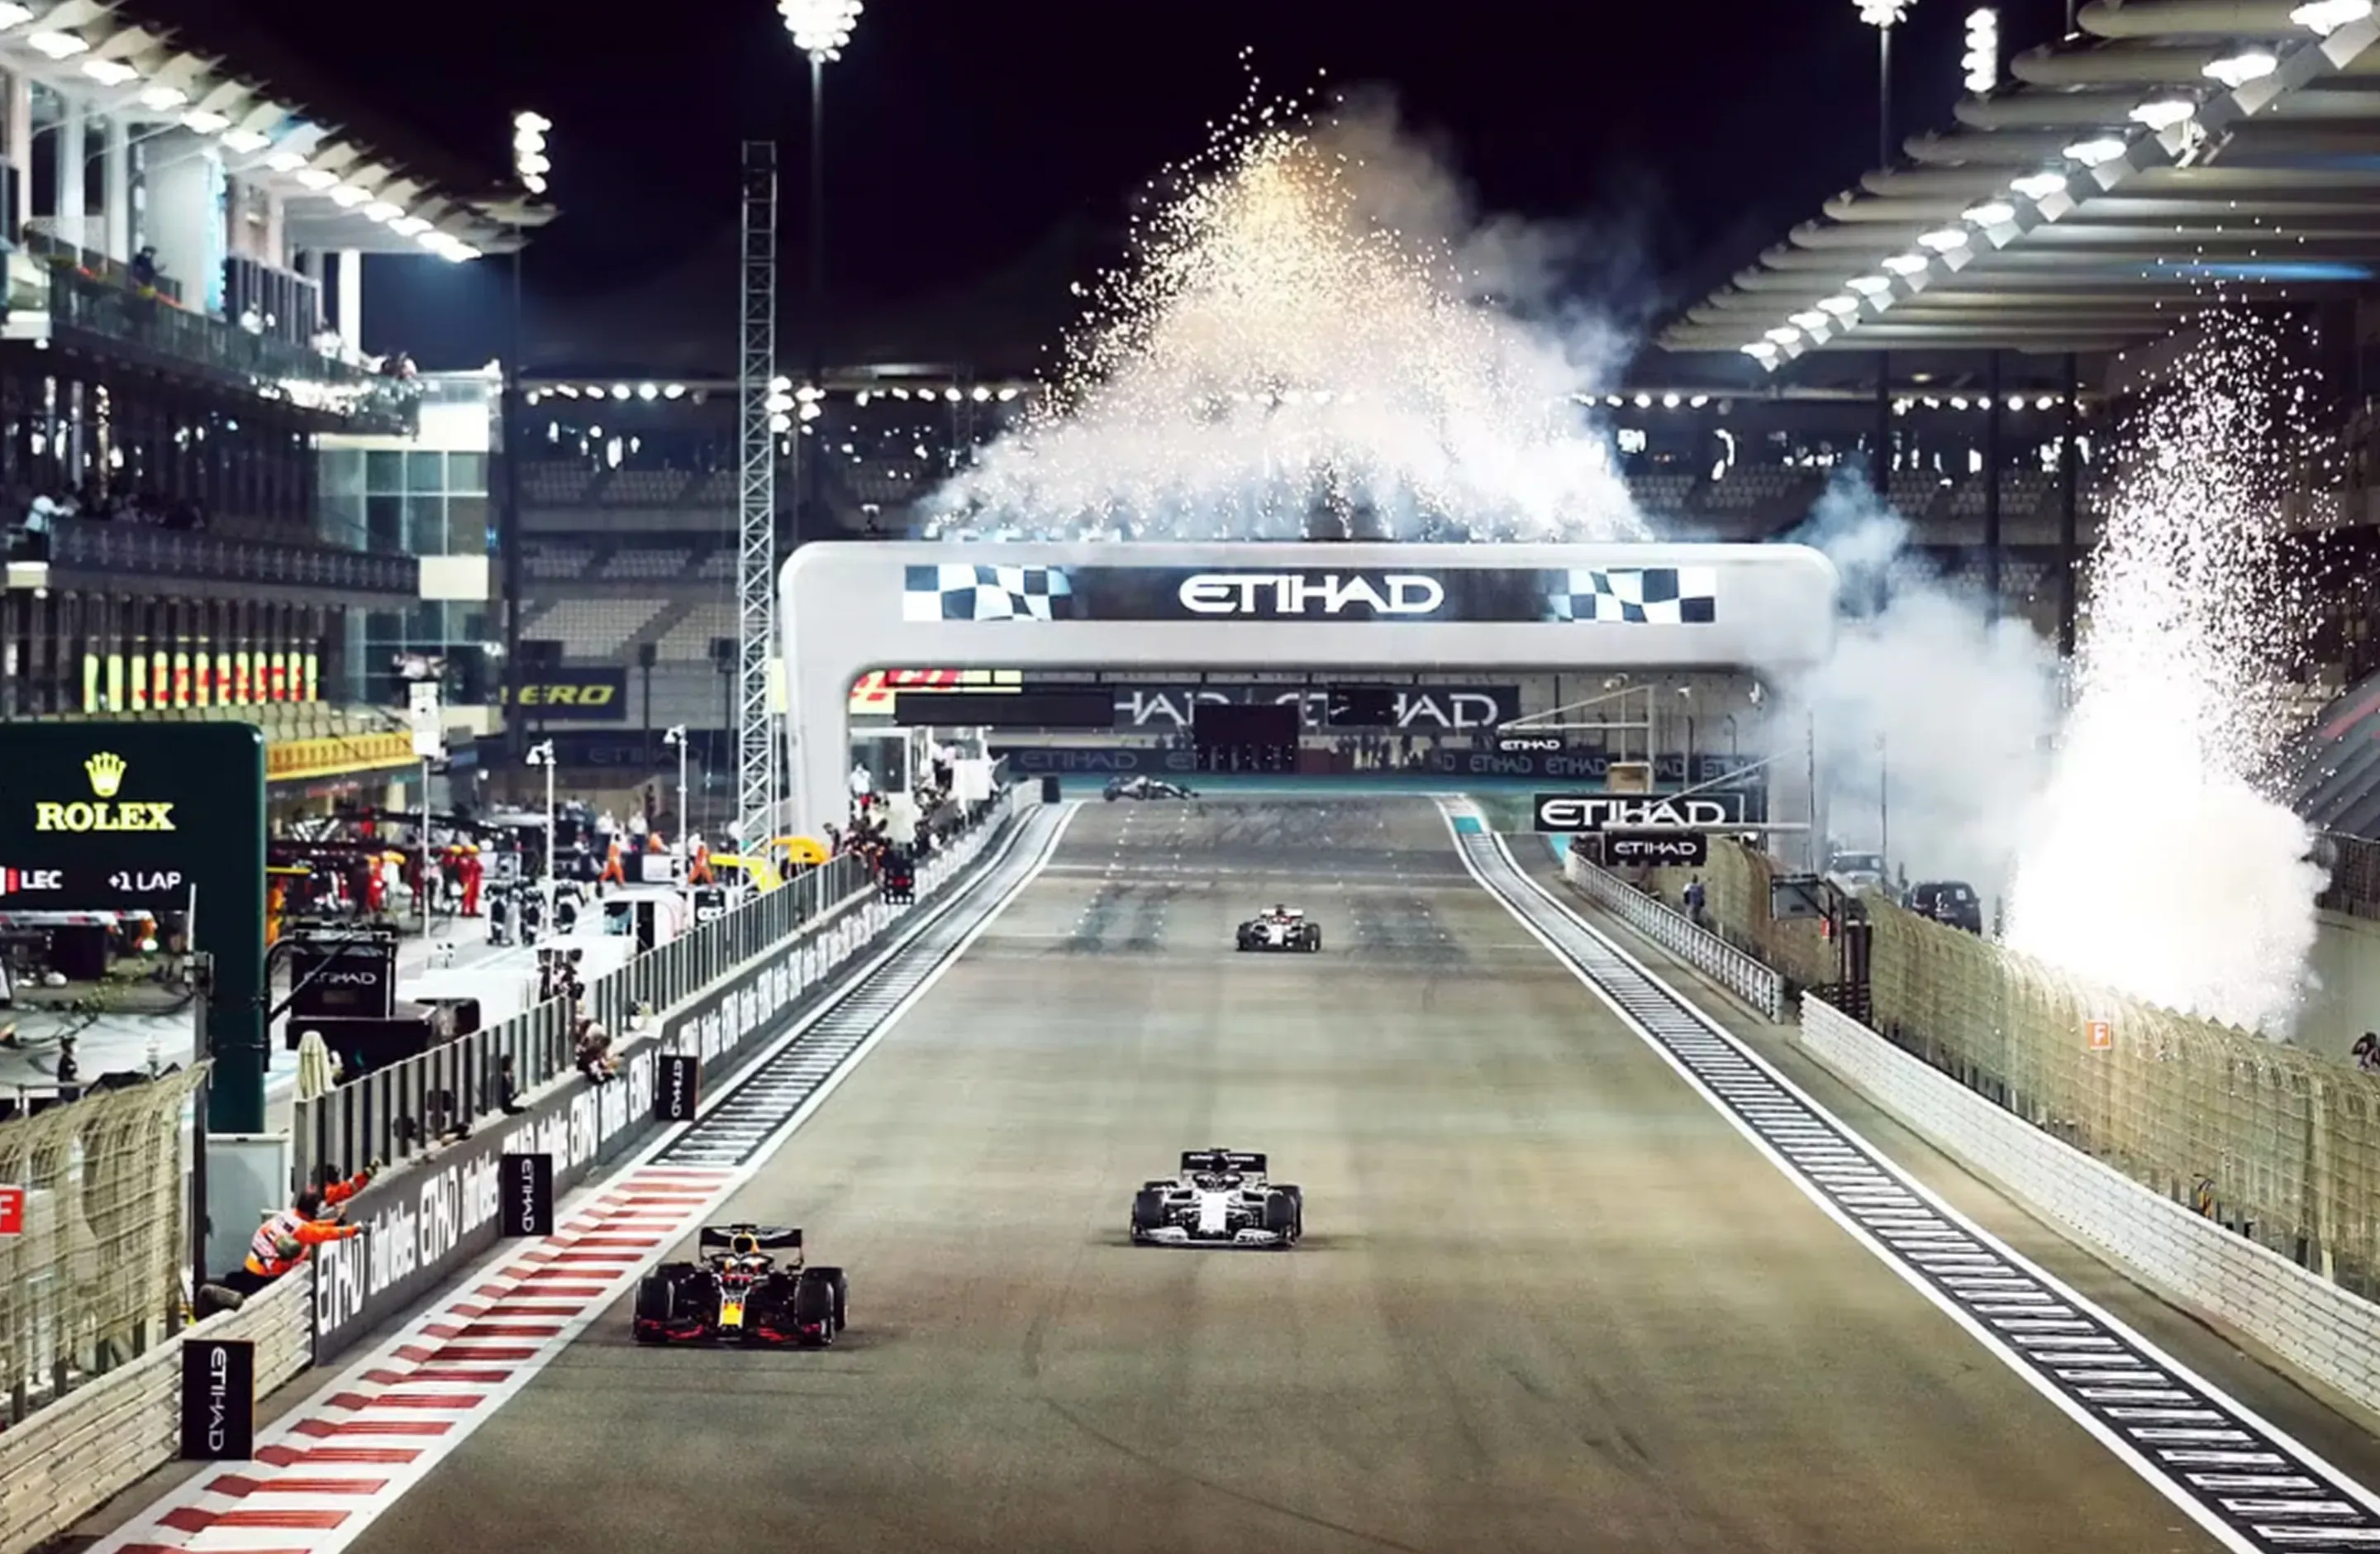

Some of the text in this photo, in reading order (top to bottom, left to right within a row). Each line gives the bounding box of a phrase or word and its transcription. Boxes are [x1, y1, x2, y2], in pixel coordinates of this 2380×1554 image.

[1179, 574, 1445, 613] ETIHAD
[501, 685, 615, 704] ERO
[1499, 739, 1561, 751] ETIHAD
[1020, 751, 1138, 770] ETIHAD
[36, 802, 177, 832] ROLEX
[1540, 798, 1726, 827] ETIHAD
[1614, 841, 1697, 856] ETIHAD
[21, 870, 182, 891] LEC +1 LAP
[2094, 1024, 2106, 1044] F
[521, 1158, 536, 1233] ETIHAD
[208, 1345, 227, 1452] ETIHAD
